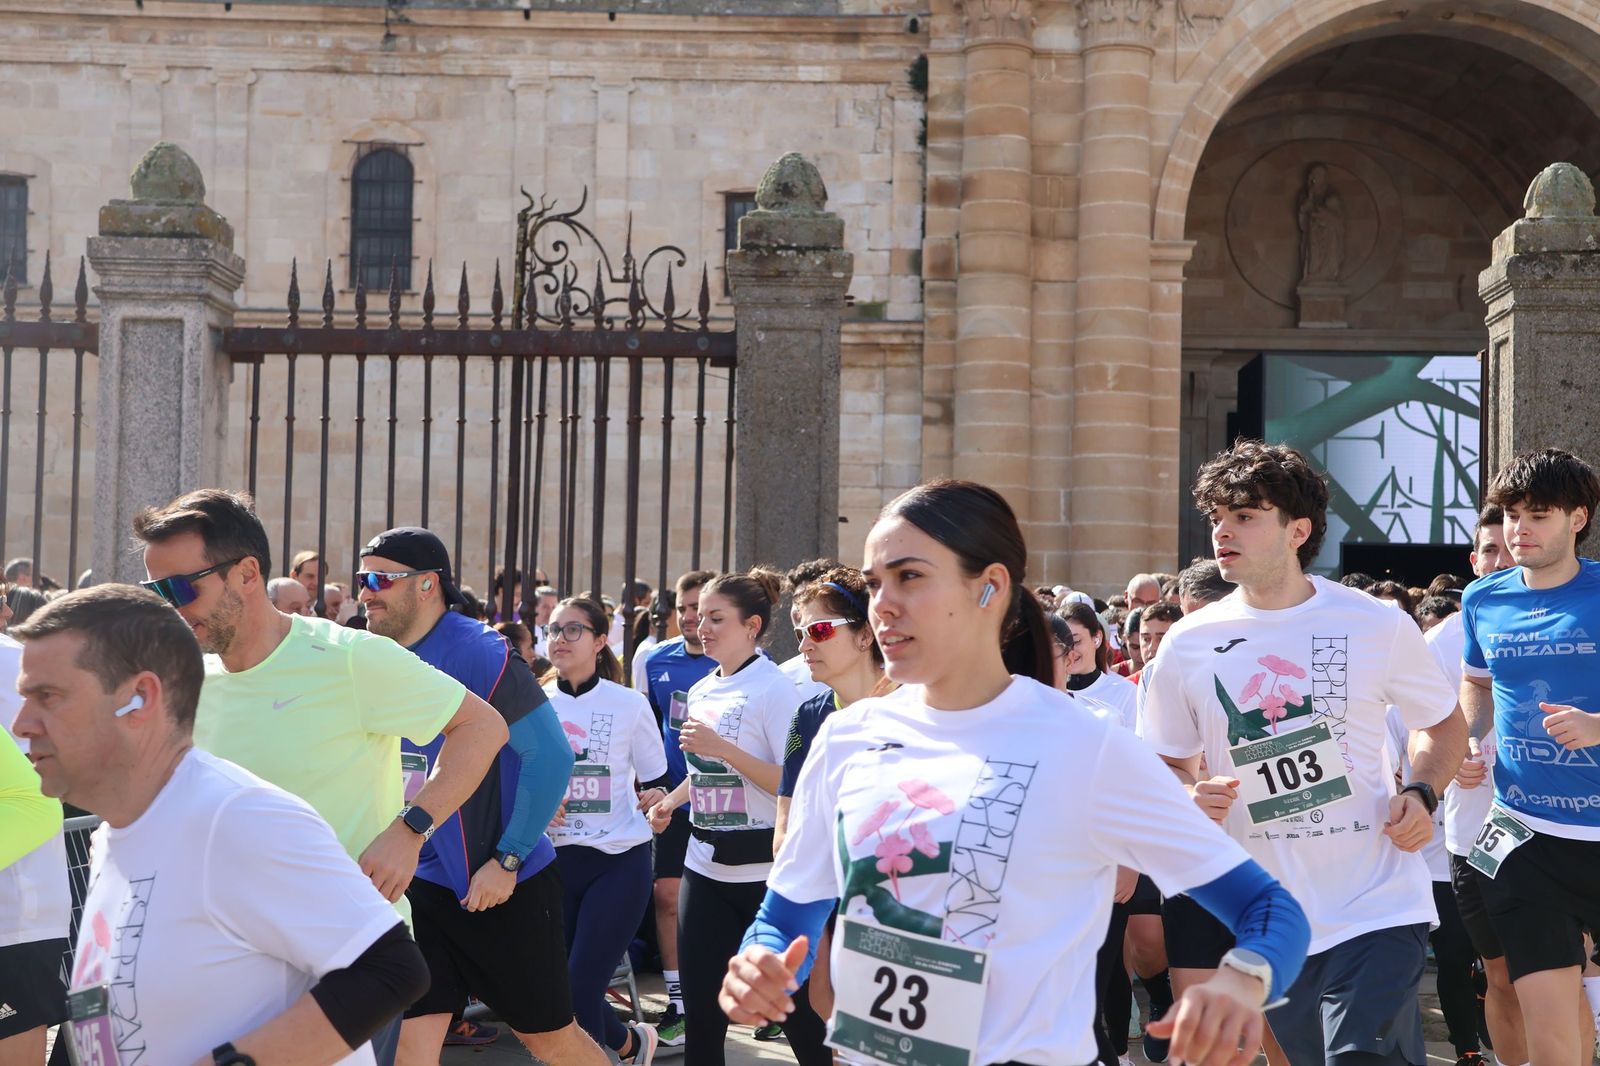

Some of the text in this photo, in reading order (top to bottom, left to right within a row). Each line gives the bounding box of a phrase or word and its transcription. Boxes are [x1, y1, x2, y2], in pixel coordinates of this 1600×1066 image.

[1487, 628, 1589, 643] TRAIL DA
[1484, 642, 1597, 659] AMIZADE
[1501, 736, 1600, 767] TDA
[1256, 749, 1324, 795] 103
[563, 777, 600, 800] 59
[695, 788, 733, 812] 517
[869, 965, 929, 1031] 23
